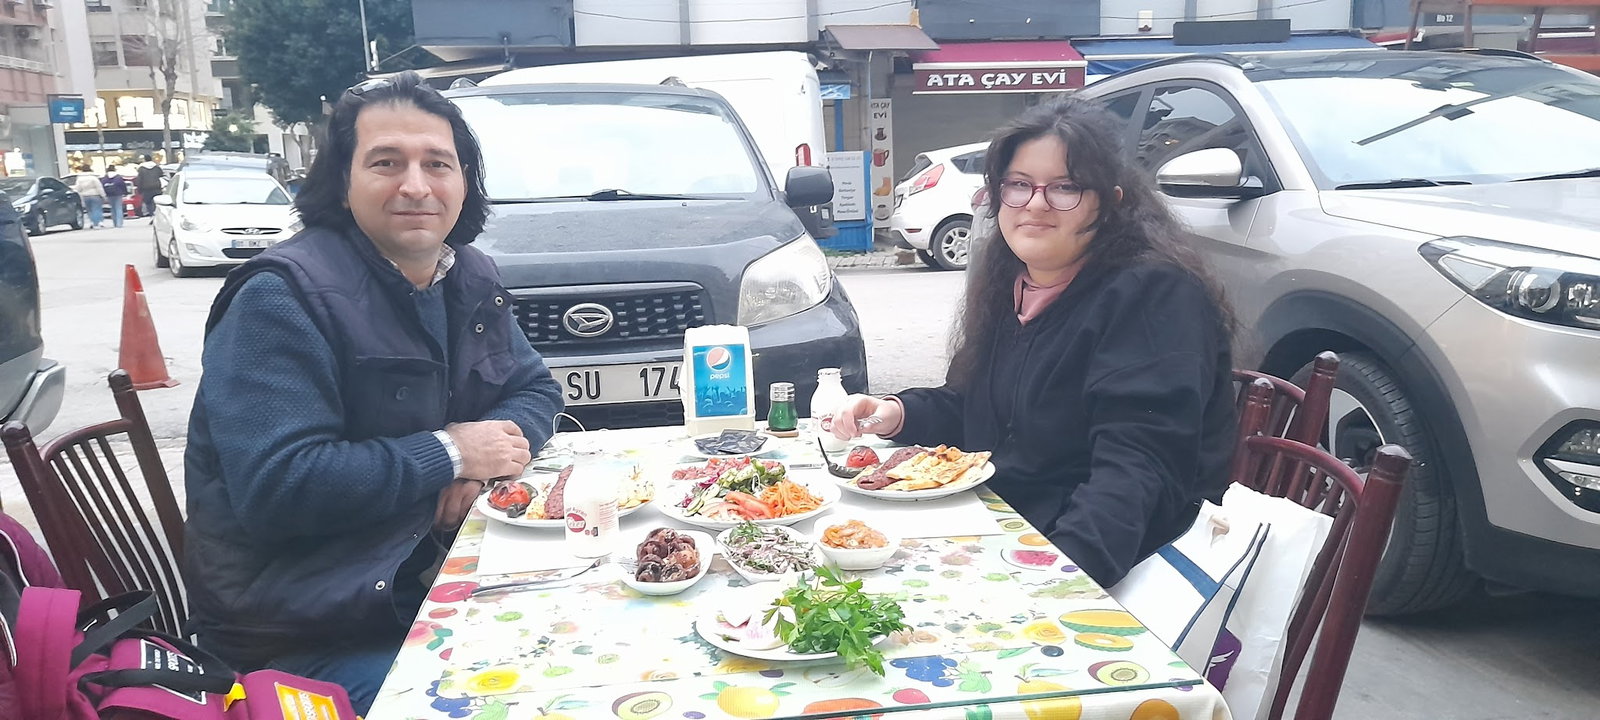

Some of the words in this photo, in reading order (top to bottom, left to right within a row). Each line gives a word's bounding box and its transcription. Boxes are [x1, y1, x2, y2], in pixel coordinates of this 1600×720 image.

[927, 73, 975, 87] ATA
[980, 73, 1027, 89] ÇAY
[1031, 69, 1067, 85] EVİ
[566, 370, 601, 401] SU
[710, 371, 730, 381] pepsi
